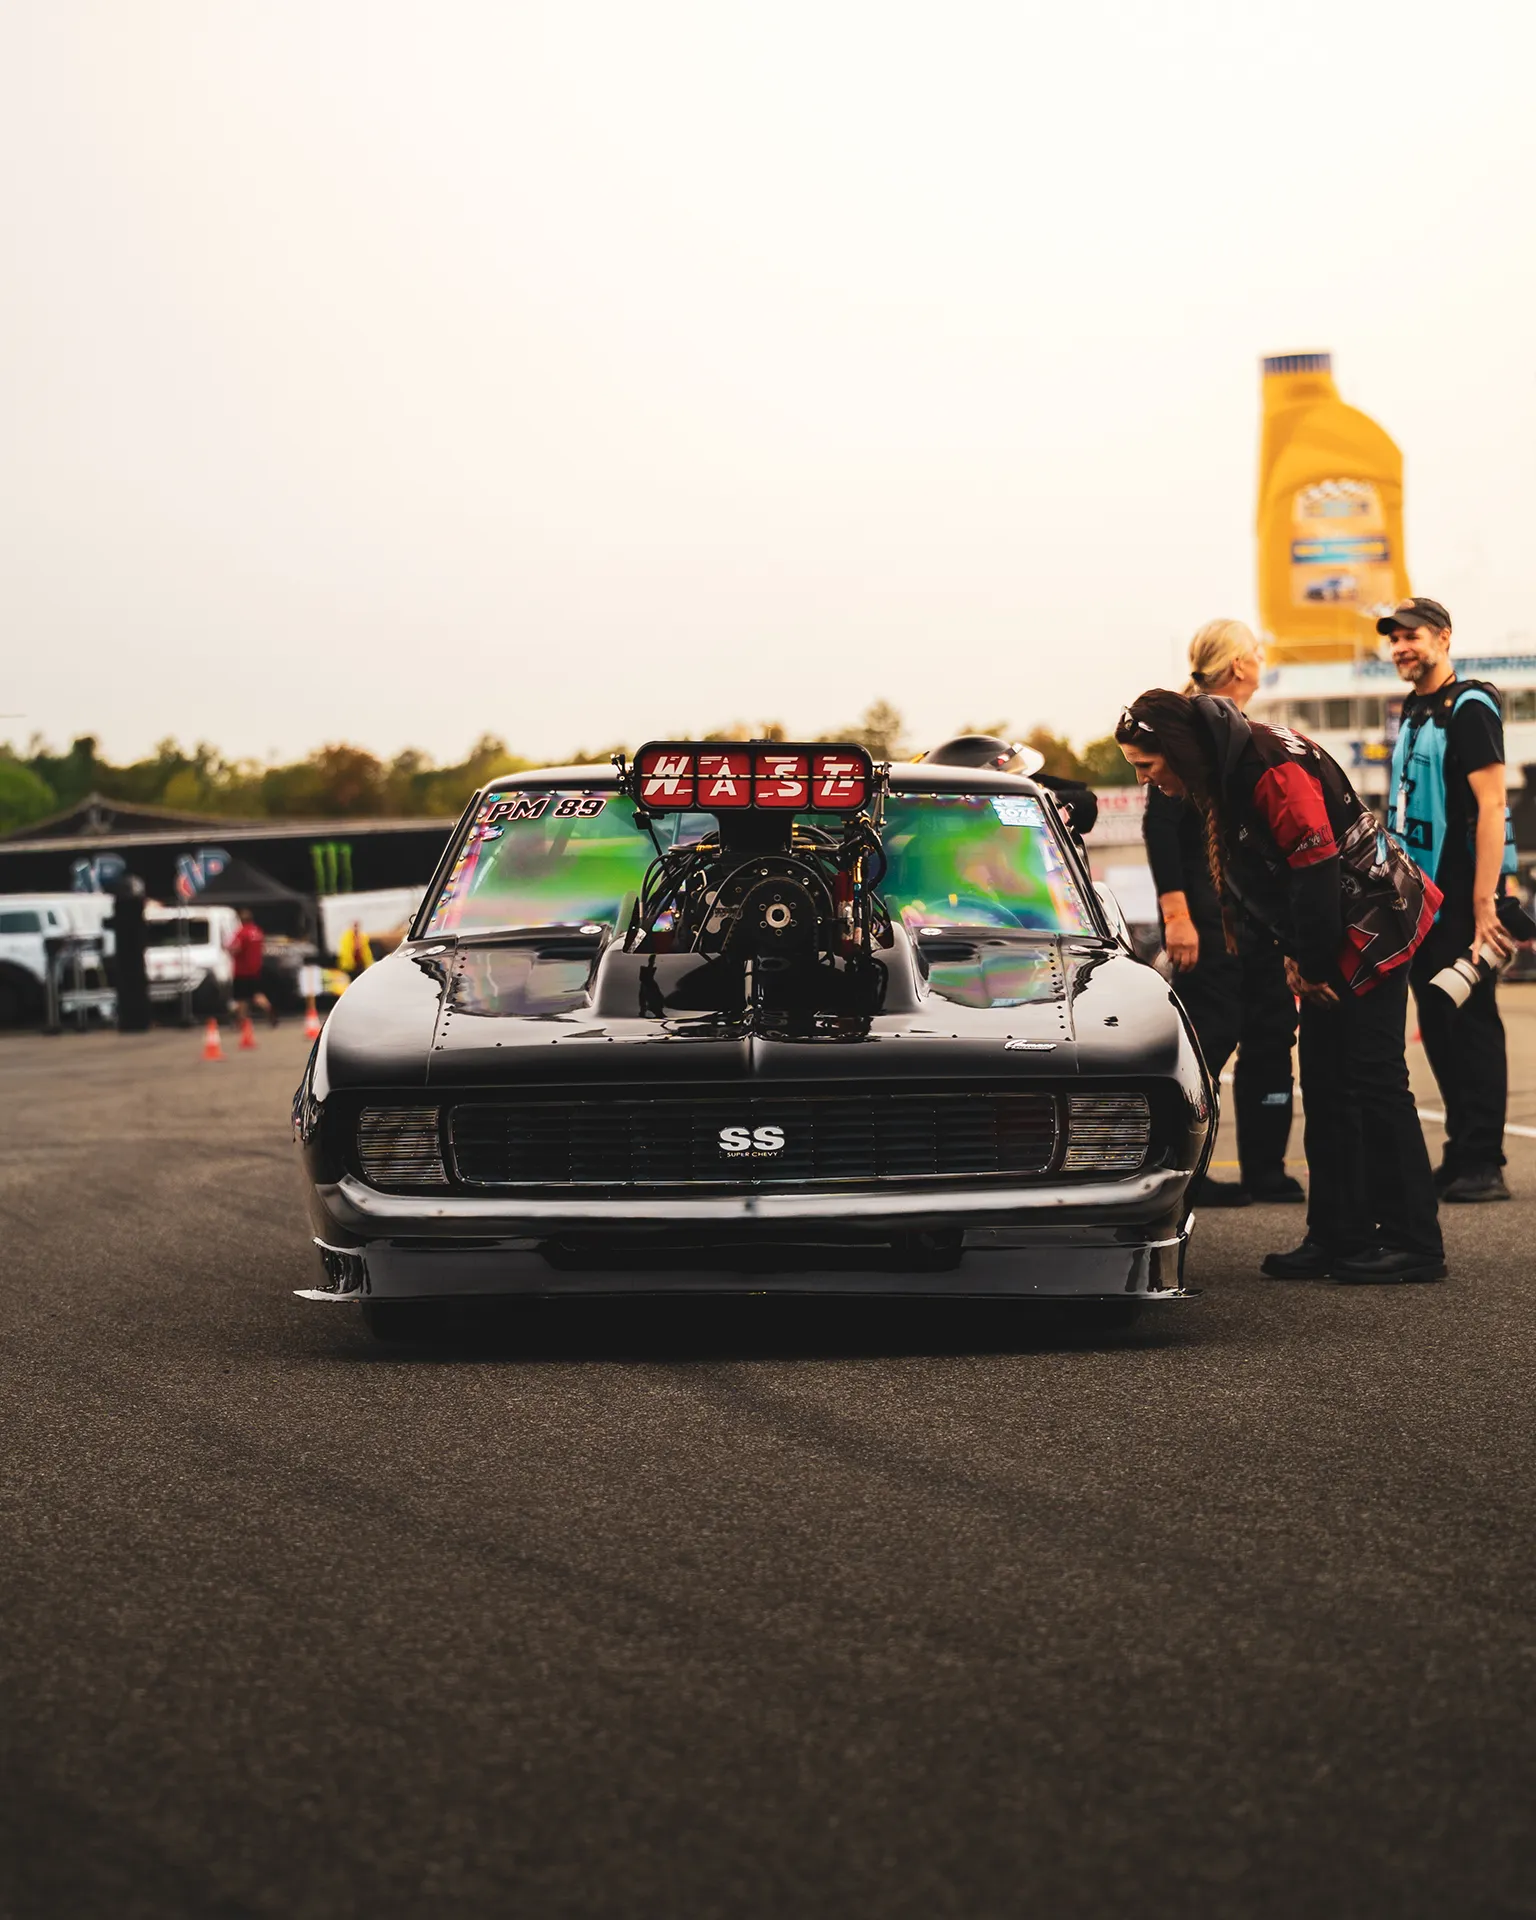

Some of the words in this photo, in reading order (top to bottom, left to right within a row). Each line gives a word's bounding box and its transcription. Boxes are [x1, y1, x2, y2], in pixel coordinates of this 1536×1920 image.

[485, 798, 551, 823] PM
[553, 798, 607, 818] 89
[719, 1127, 785, 1151] SS
